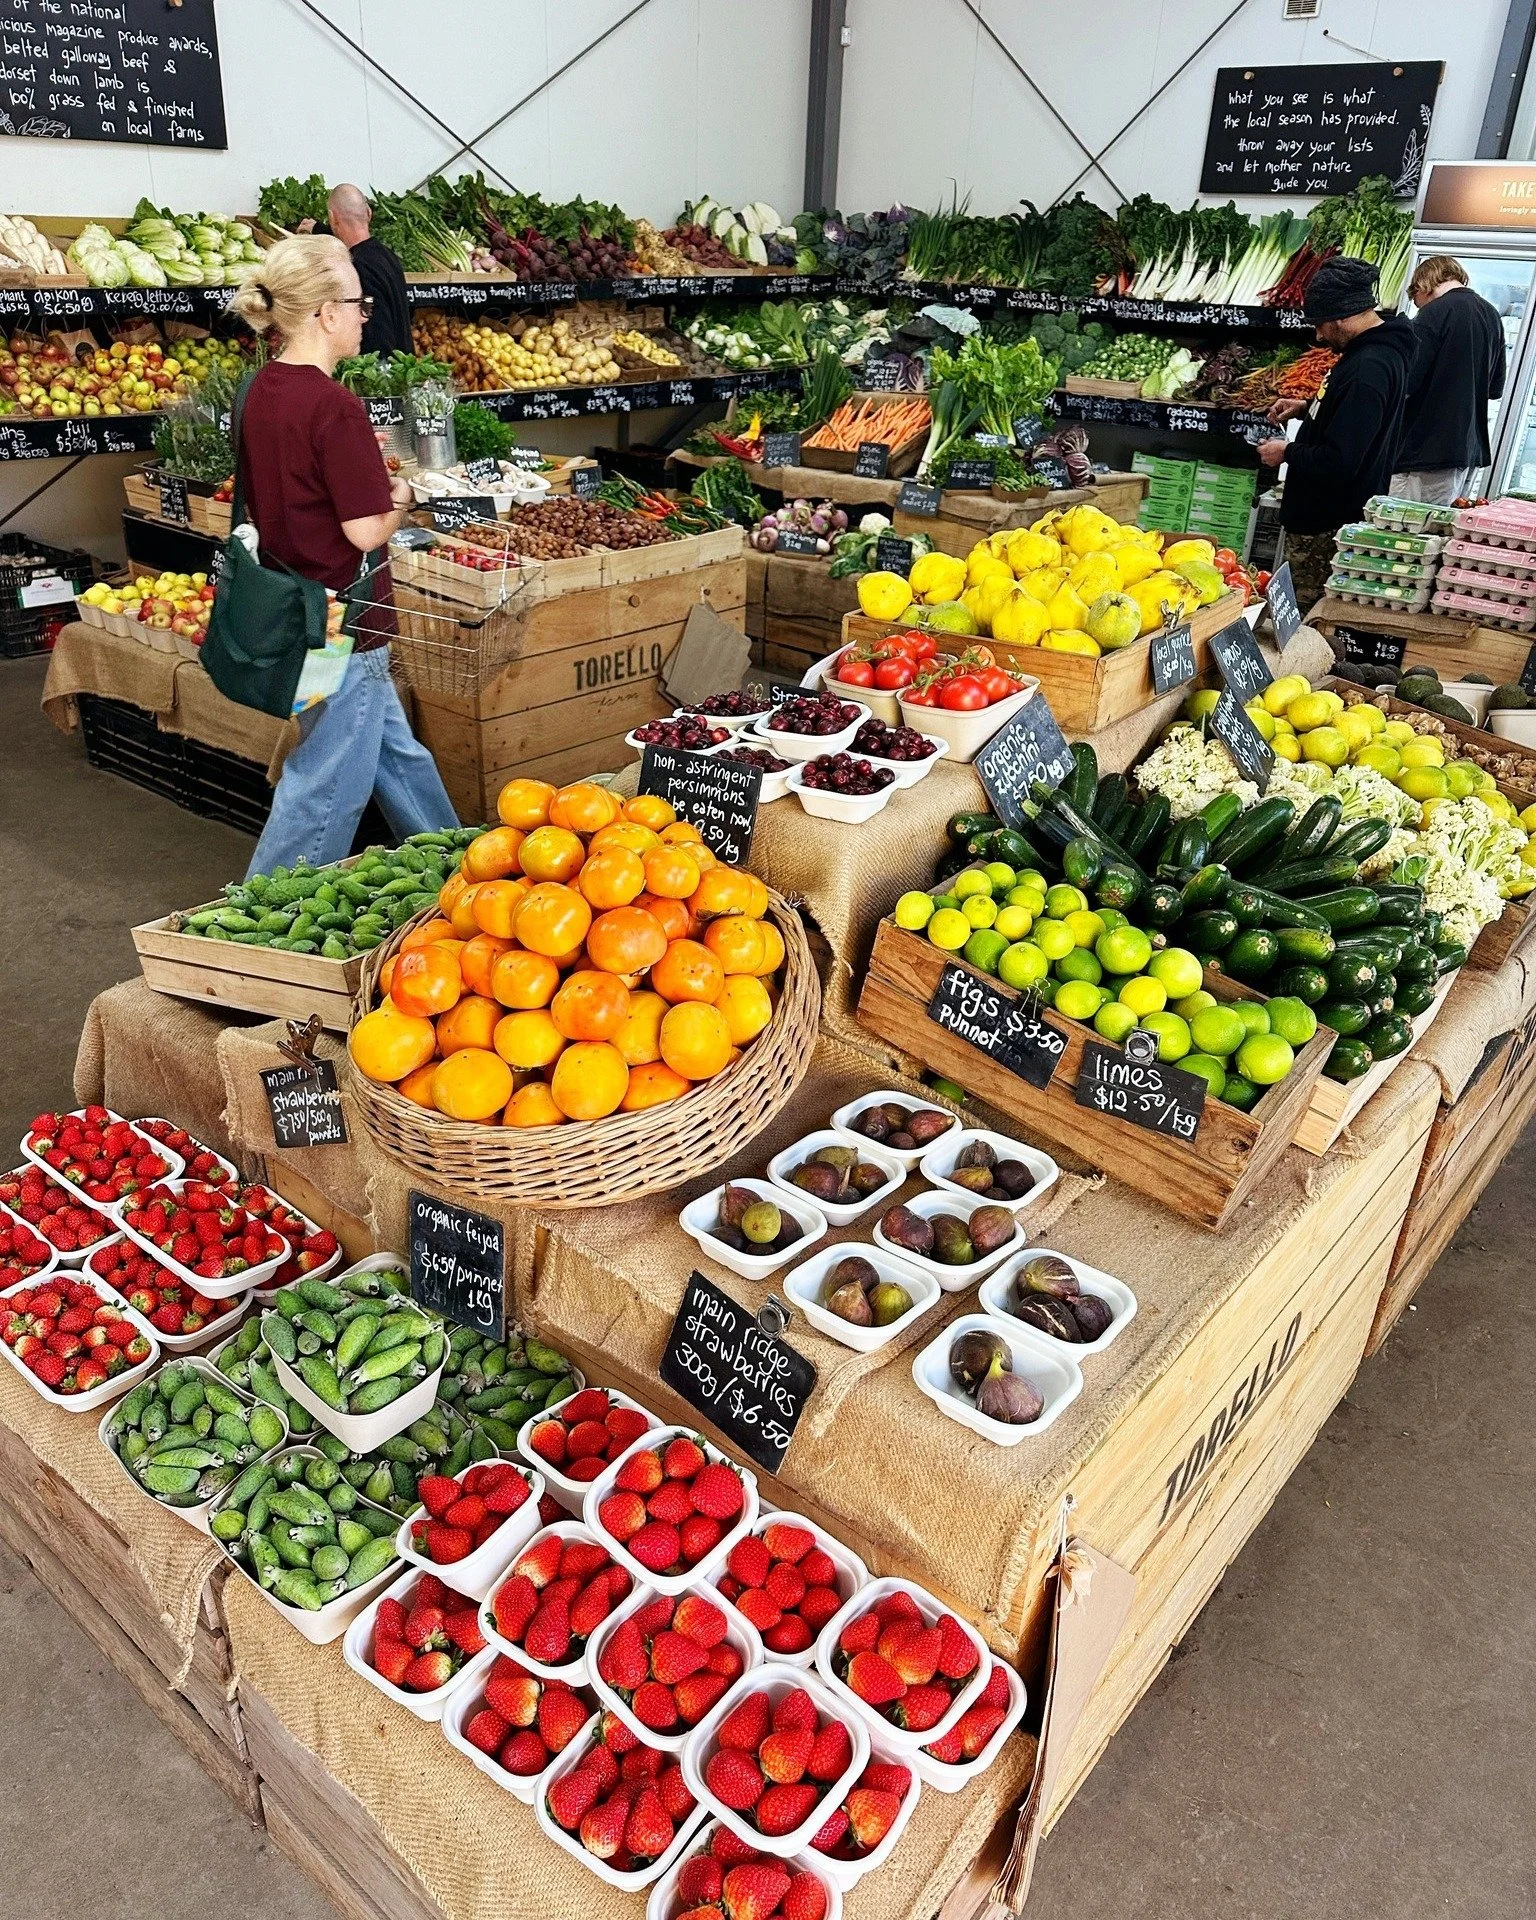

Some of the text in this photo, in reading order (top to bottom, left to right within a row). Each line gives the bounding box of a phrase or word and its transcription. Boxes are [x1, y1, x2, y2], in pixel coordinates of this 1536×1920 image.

[39, 0, 62, 14] the
[71, 0, 125, 23] national
[3, 35, 176, 74] belted galloway beef &
[118, 29, 159, 50] produce
[169, 36, 212, 59] awards,
[0, 61, 150, 93] dorset down lamb is
[9, 87, 194, 119] 100% grass fed & finished
[1228, 87, 1376, 110] what you see is what
[101, 116, 204, 141] on local farms
[1223, 105, 1400, 134] the local season has provided.
[1237, 137, 1374, 158] throw away your lists
[1216, 157, 1352, 174] and let mother nature
[1271, 177, 1299, 192] guide
[34, 289, 79, 303] daikon
[146, 289, 189, 303] lettuce
[370, 400, 392, 413] basil
[65, 421, 90, 439] fuji
[573, 643, 662, 690] TORELLO
[984, 723, 1026, 778] organic
[668, 777, 746, 806] persimmons
[672, 796, 686, 812] be
[693, 801, 725, 821] eaten
[947, 970, 1000, 1018] figs
[267, 1070, 295, 1087] main
[1096, 1054, 1163, 1091] limes
[417, 1203, 500, 1255] organic feijoa
[693, 1287, 792, 1377] main ridge
[685, 1313, 797, 1418] strawberries
[1158, 1310, 1303, 1528] TORELLO
